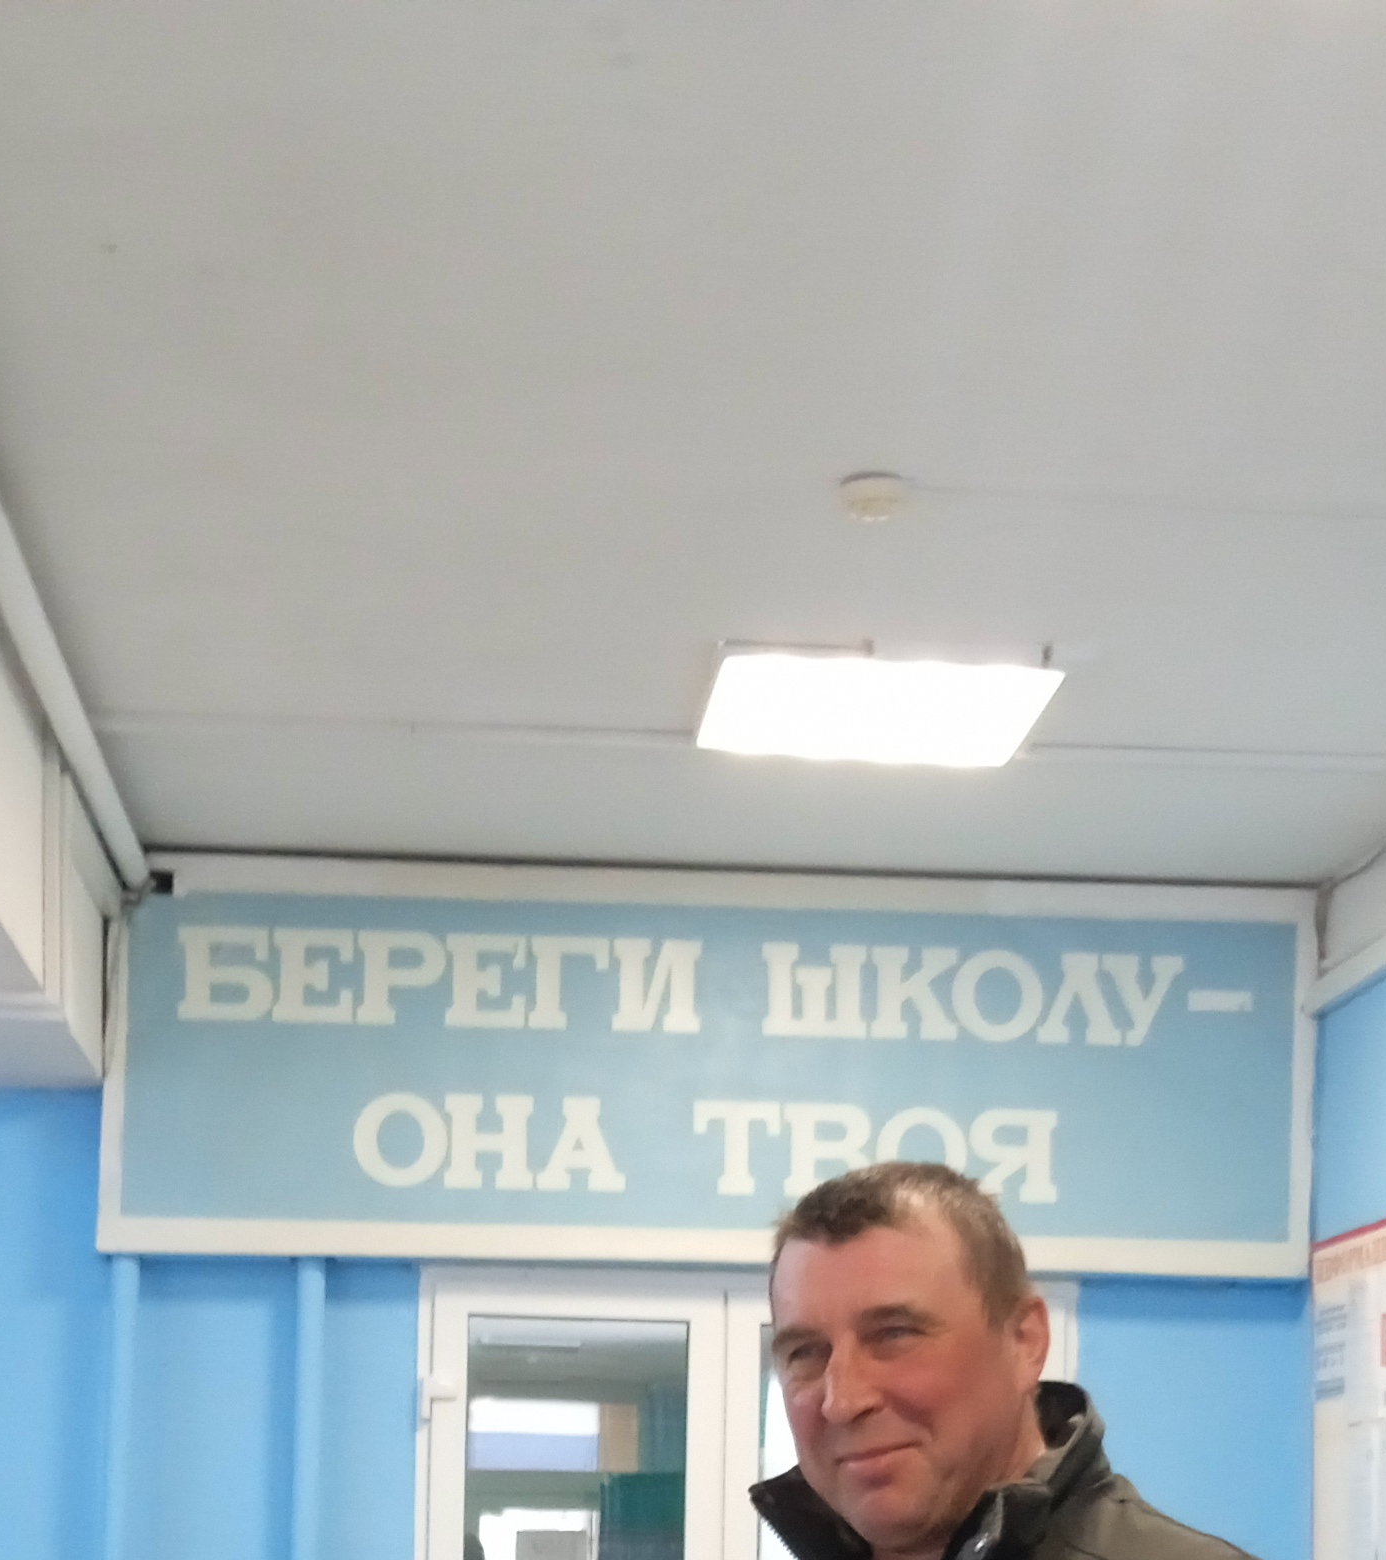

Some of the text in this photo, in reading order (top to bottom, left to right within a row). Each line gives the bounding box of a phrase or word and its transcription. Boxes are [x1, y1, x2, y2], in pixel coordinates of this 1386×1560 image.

[177, 926, 702, 1034] БЕРЕГИ
[353, 1092, 1058, 1203] ОНА ТВОЯ
